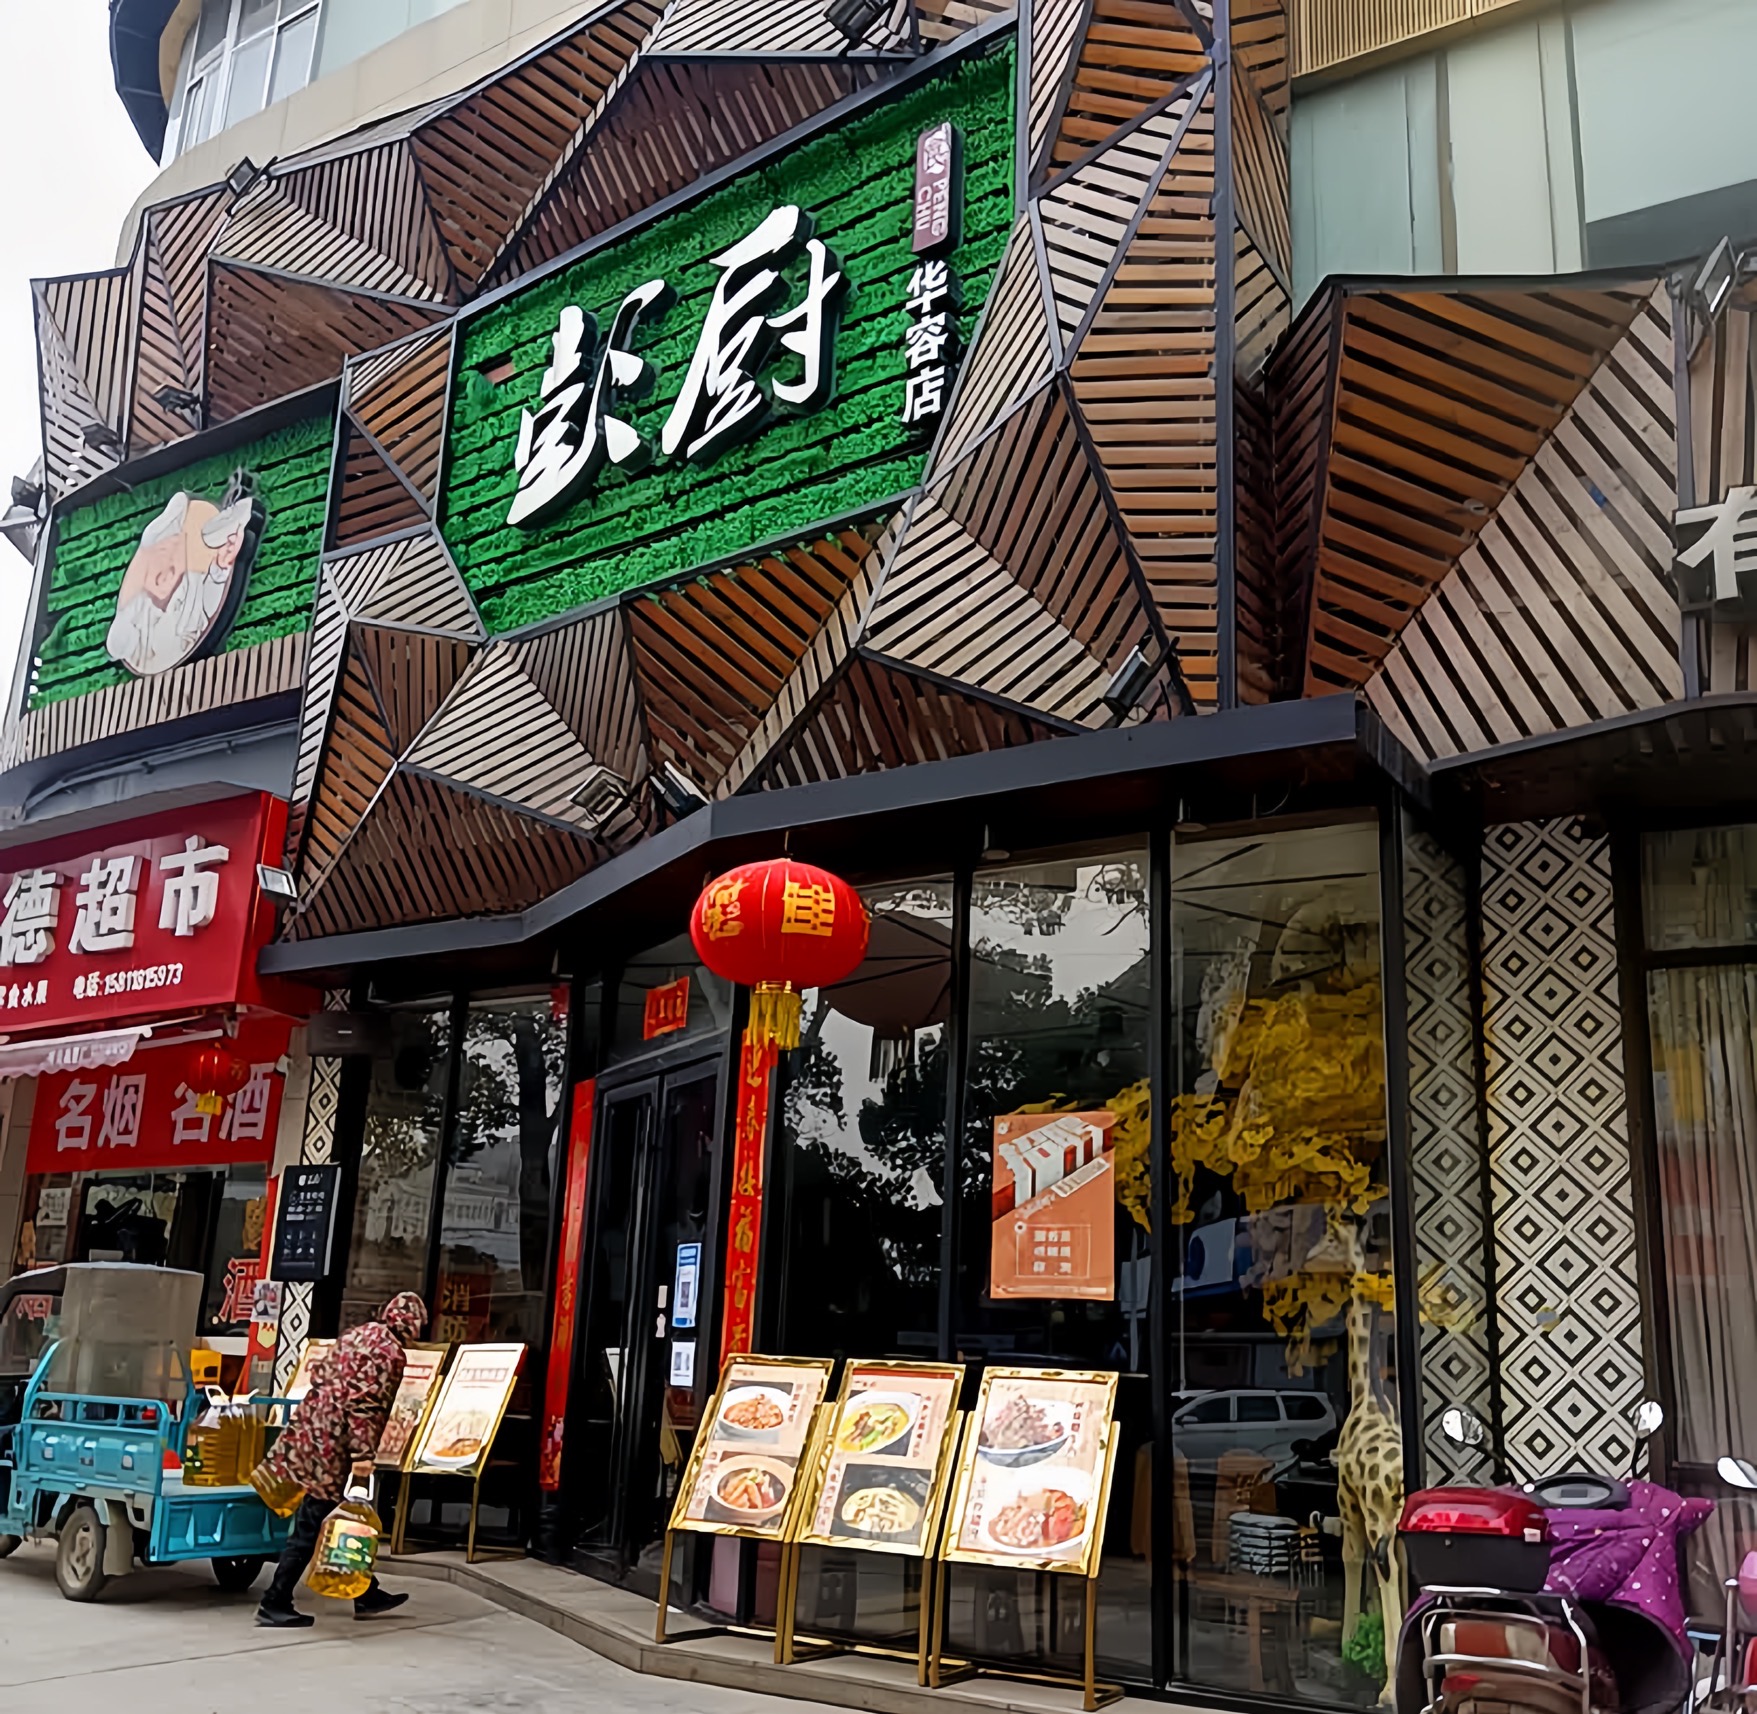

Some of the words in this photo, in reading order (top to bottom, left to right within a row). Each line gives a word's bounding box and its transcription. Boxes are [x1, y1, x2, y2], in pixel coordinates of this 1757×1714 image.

[915, 185, 932, 230] CHU
[506, 205, 841, 525] 彭厨
[901, 260, 948, 423] 华容店
[0, 834, 229, 967] 德超市
[55, 1073, 147, 1152] 名烟
[172, 1062, 275, 1142] 名酒
